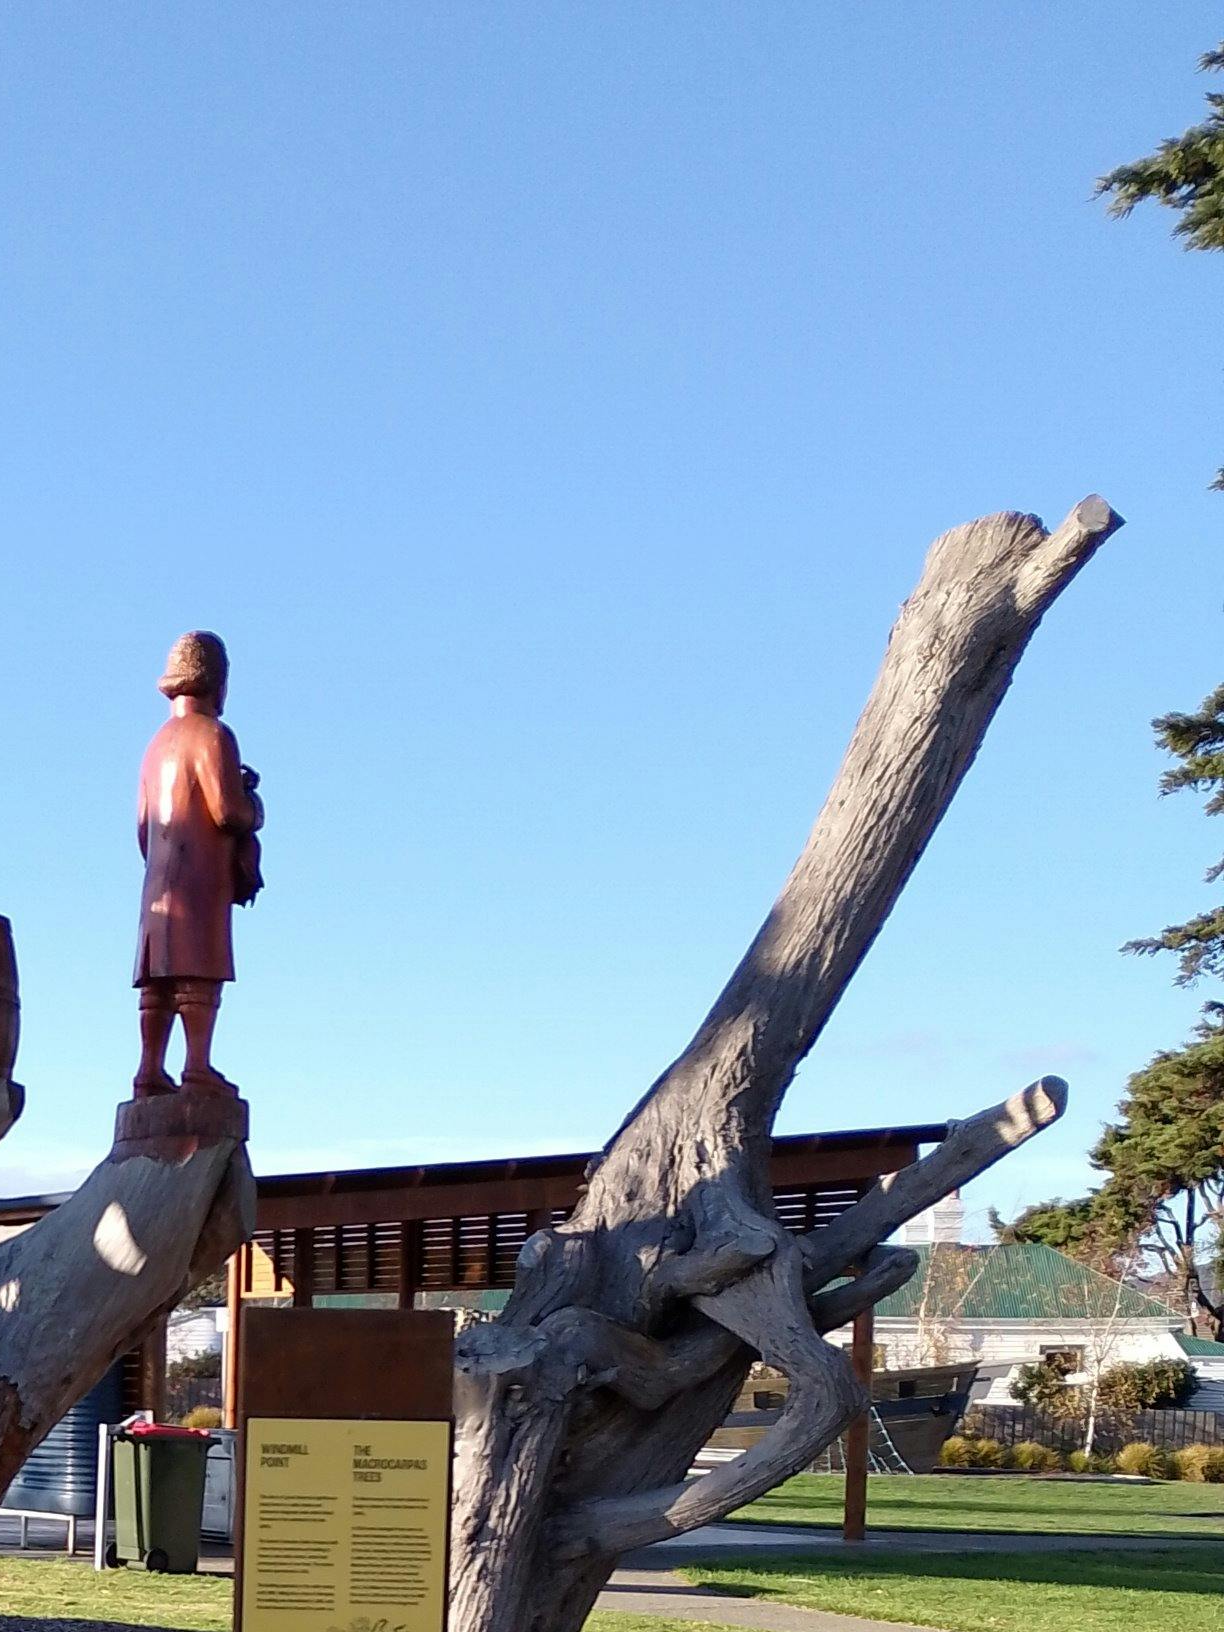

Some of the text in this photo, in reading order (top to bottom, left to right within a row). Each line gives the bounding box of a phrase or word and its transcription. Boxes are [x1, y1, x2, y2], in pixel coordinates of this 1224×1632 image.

[260, 1444, 309, 1455] WINDMILL
[353, 1445, 371, 1456] THE
[260, 1457, 289, 1467] POINT
[353, 1471, 381, 1482] TREES
